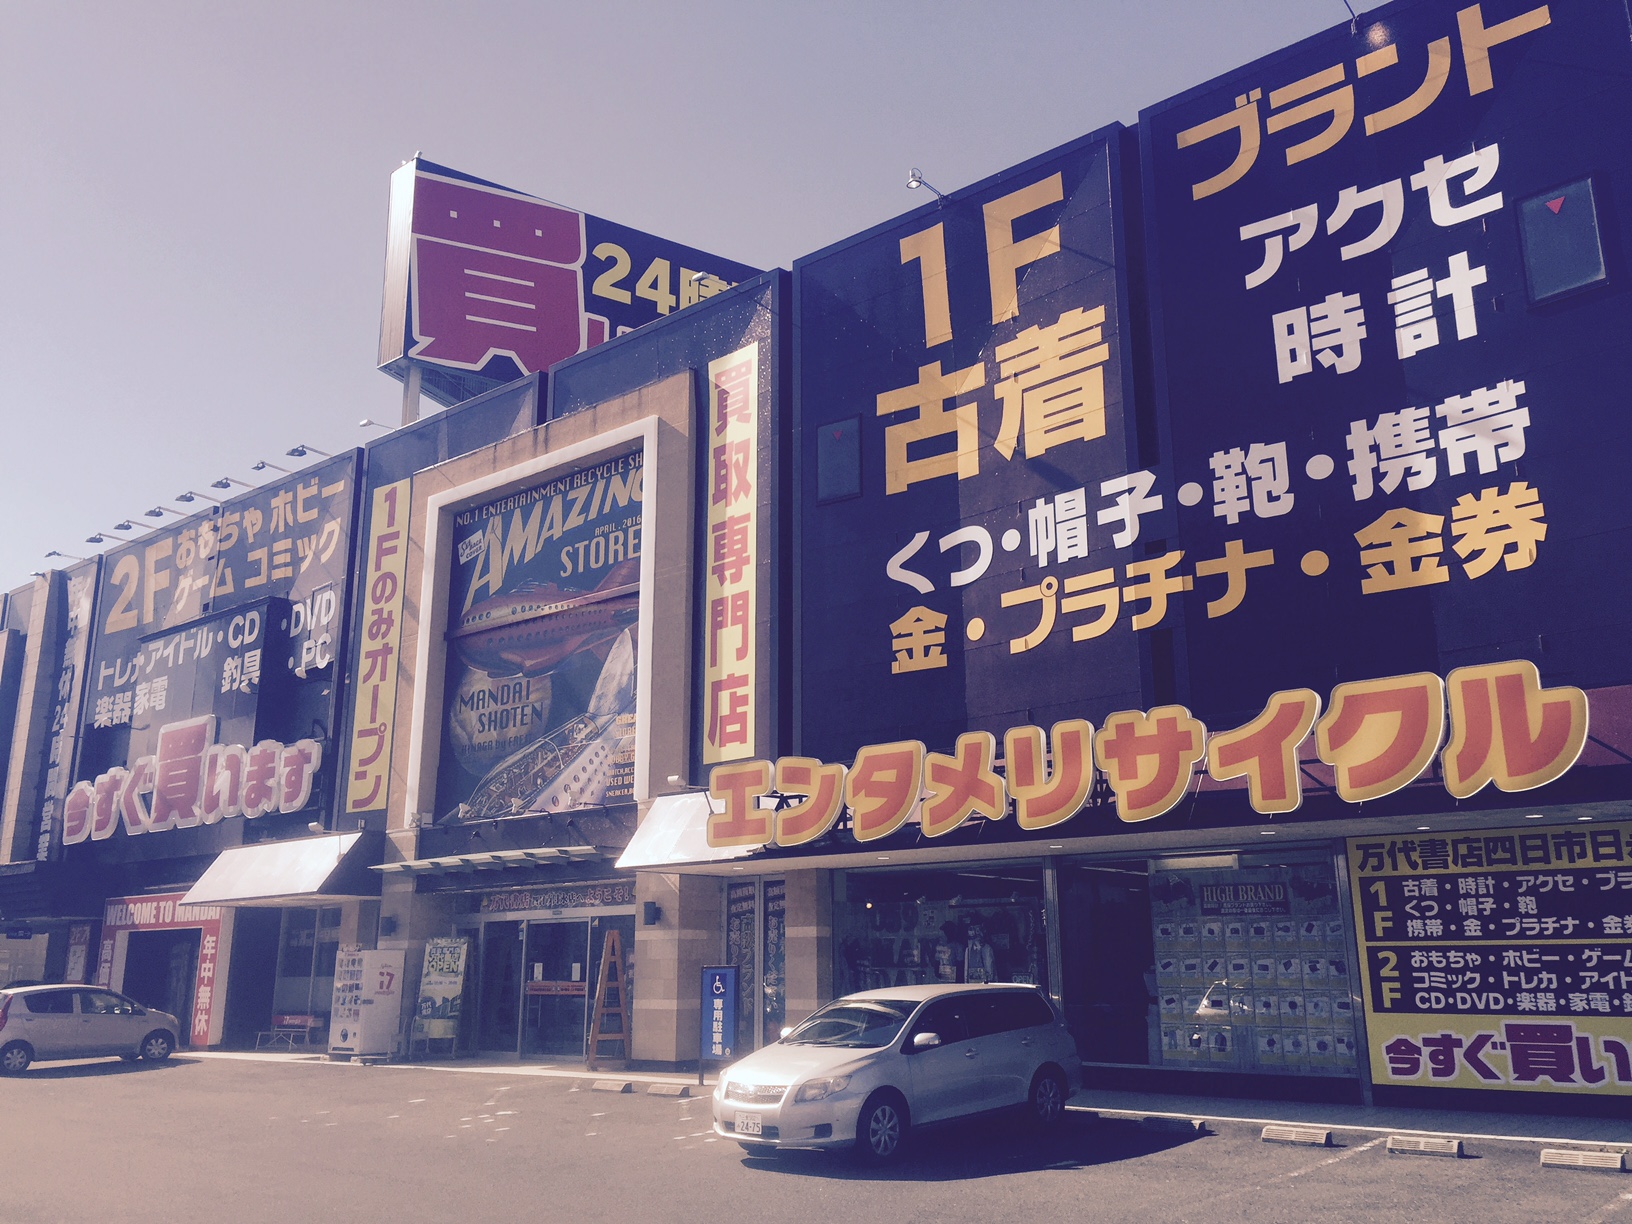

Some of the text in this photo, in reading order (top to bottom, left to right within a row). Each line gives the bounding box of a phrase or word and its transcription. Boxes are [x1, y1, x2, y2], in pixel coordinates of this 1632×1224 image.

[899, 171, 1064, 349] 1F
[1239, 143, 1504, 290] アクセ
[1271, 250, 1488, 384] 時計
[876, 305, 1109, 496] 古着
[175, 476, 345, 570] おもちゃ ホビー
[482, 476, 571, 520] ENTERTAINMENT
[573, 457, 626, 489] RECYCLE
[628, 450, 644, 469] SH
[104, 537, 173, 635] 2F
[173, 517, 342, 614] ゲーム コミック
[707, 364, 753, 749] 買取専門店
[94, 681, 132, 730] 楽器
[134, 675, 168, 716] 家電
[221, 648, 262, 694] 釣具
[459, 679, 531, 714] MANDAI
[477, 701, 544, 734] SHOTEN
[62, 714, 322, 845] 今すぐ買います
[705, 660, 1590, 849] エンタメリサイクル
[107, 899, 157, 926] WELCOME
[159, 901, 171, 923] TO
[1203, 884, 1284, 903] HIGH BRAND
[195, 934, 217, 1036] 年中無休
[711, 998, 724, 1056] 専用駐車場
